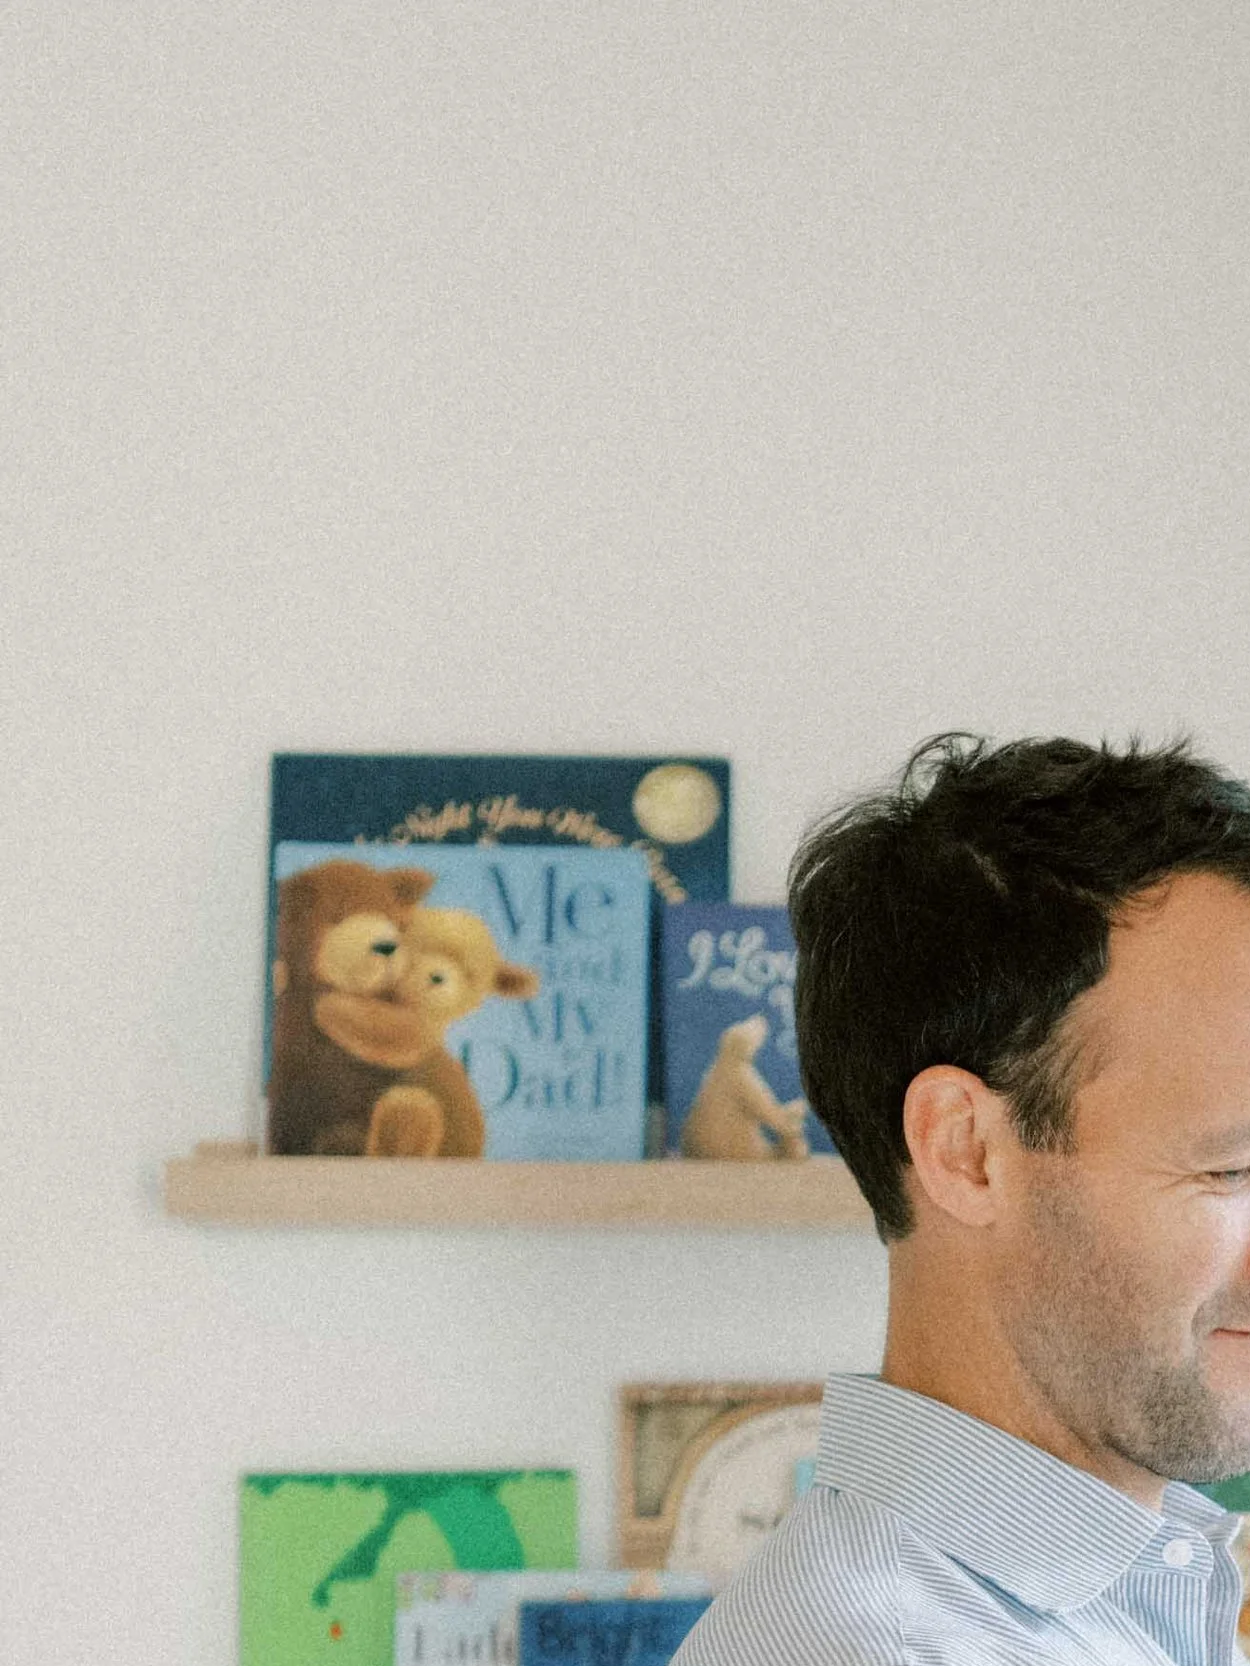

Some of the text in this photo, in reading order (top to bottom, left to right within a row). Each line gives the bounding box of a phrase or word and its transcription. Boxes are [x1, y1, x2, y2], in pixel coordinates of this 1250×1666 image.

[485, 862, 617, 945] Me
[709, 925, 798, 997] Lov
[459, 1039, 626, 1108] Dad!
